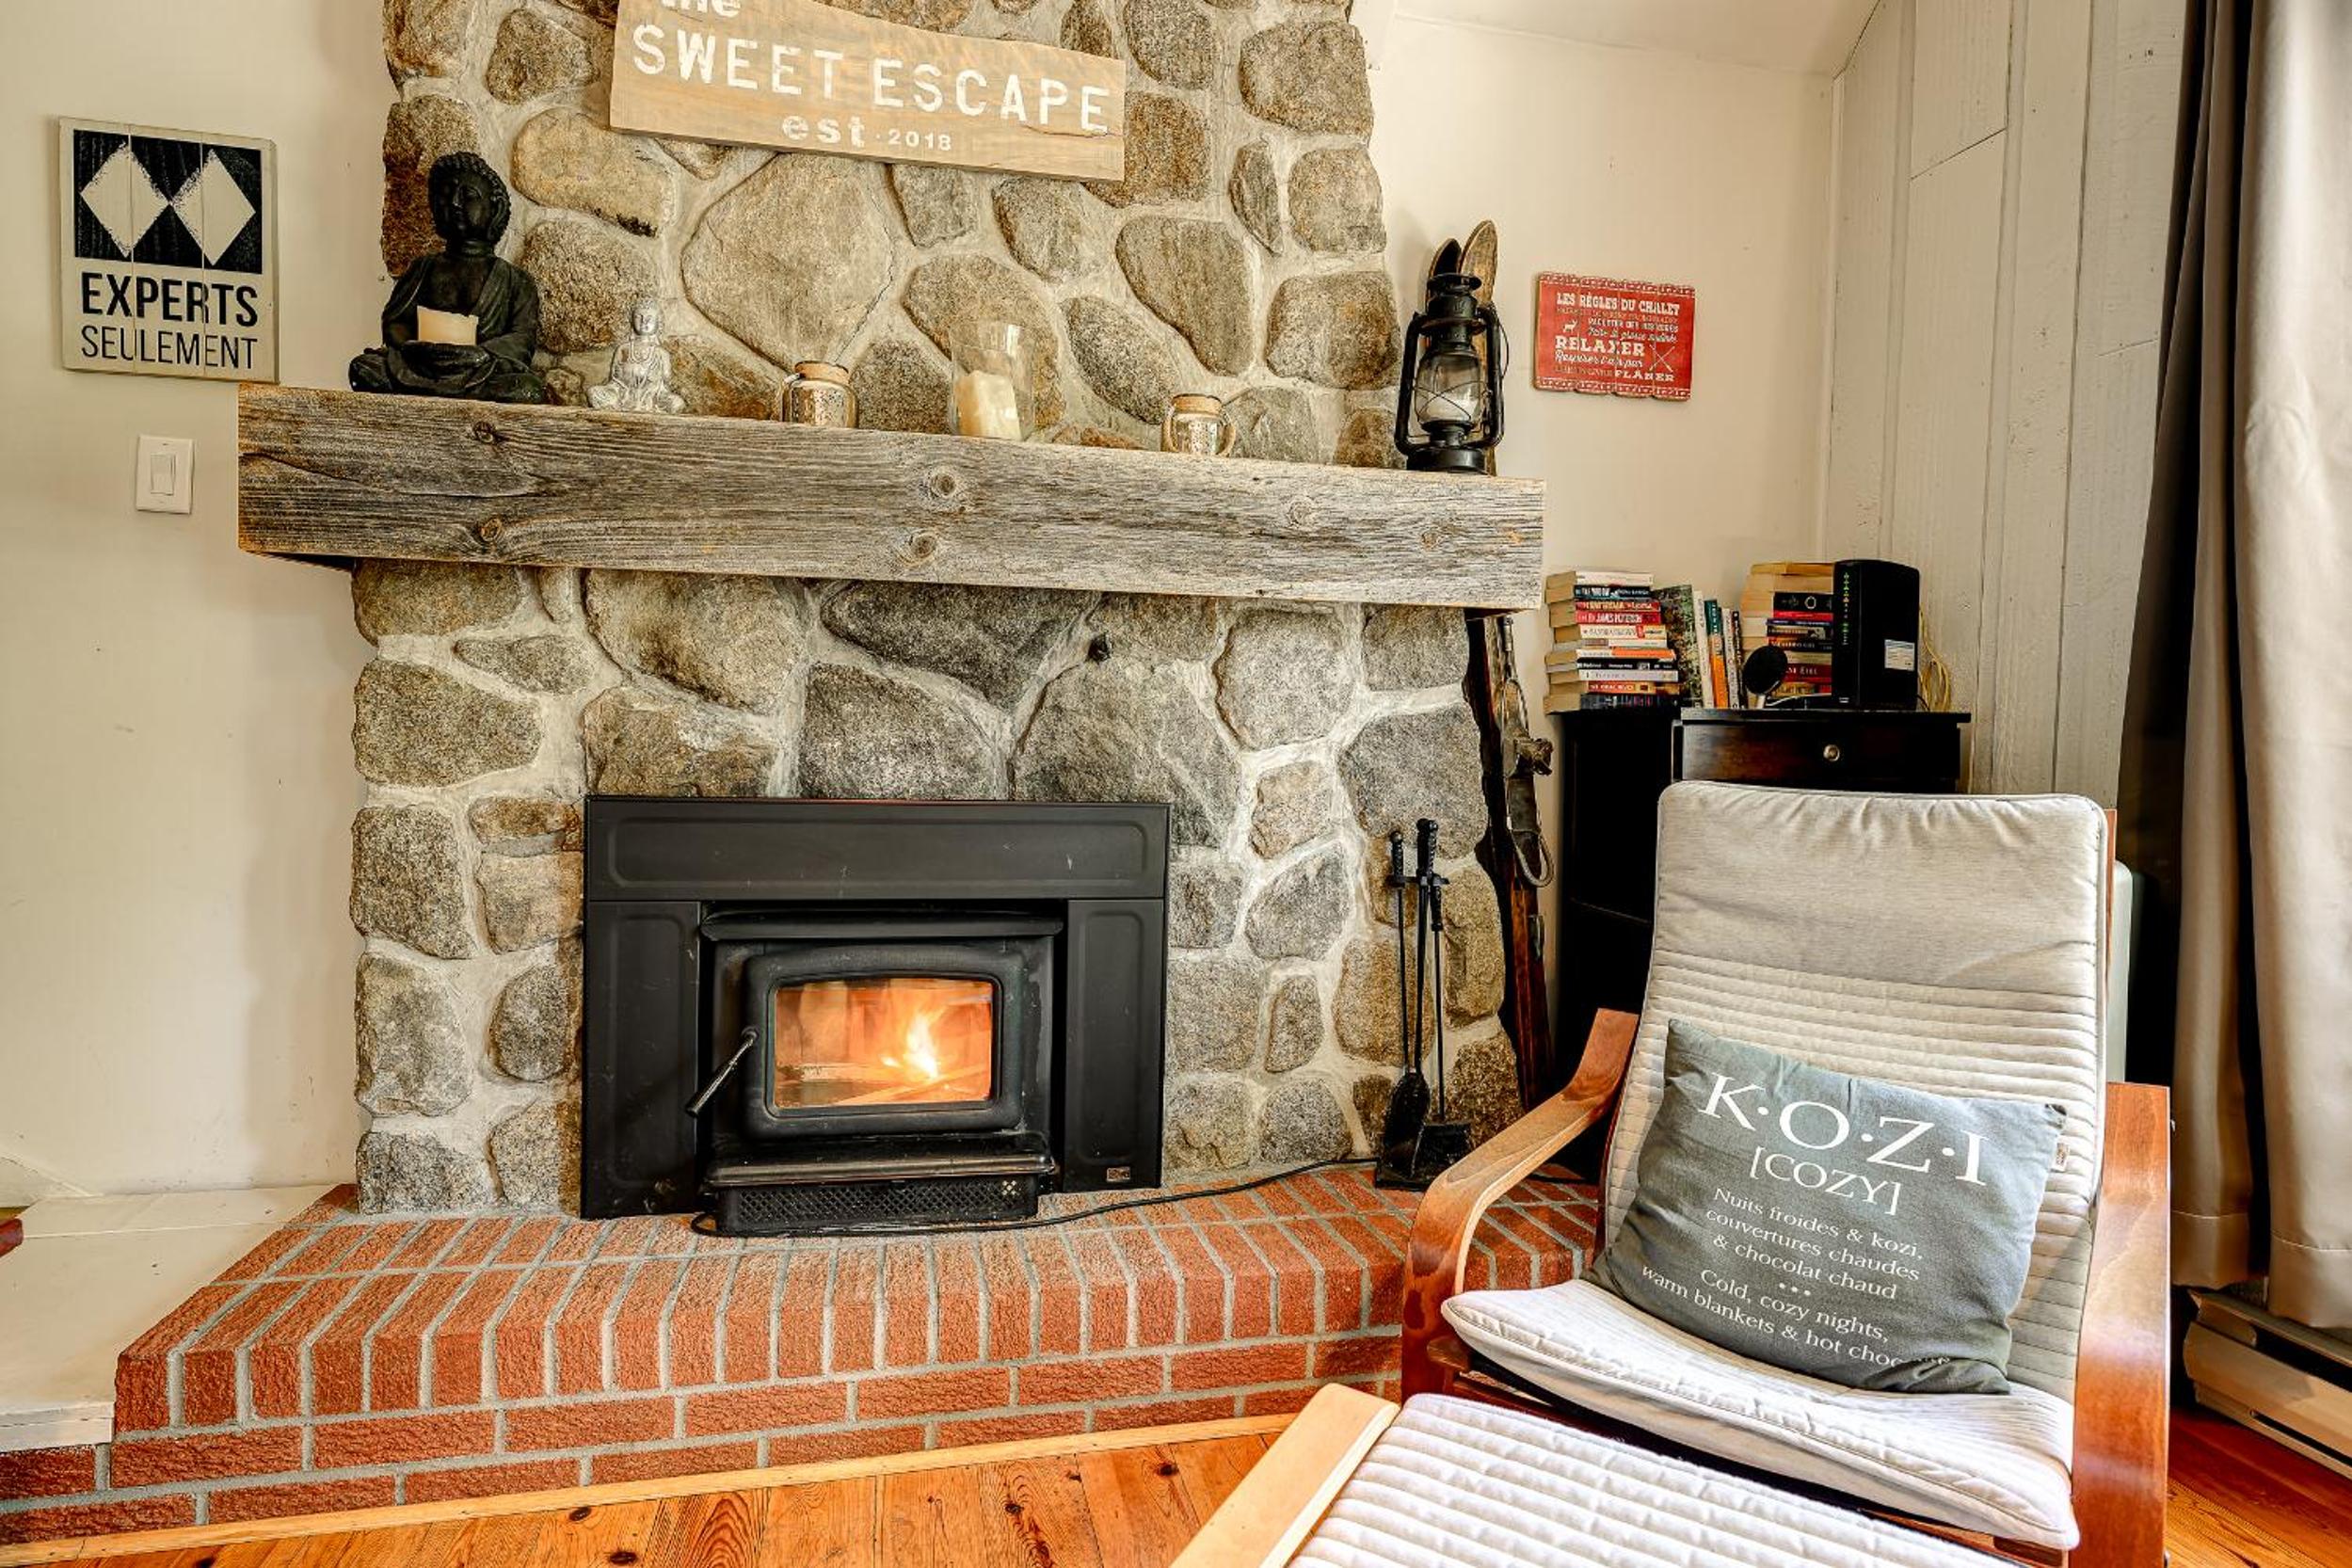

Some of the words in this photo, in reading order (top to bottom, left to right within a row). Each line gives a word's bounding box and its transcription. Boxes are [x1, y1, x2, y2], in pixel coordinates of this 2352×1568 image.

[632, 24, 844, 100] SWEET
[872, 57, 1111, 134] ESCAPE
[888, 128, 952, 152] 2018
[81, 271, 258, 328] EXPERTS
[1556, 292, 1576, 307] LES
[1621, 297, 1636, 312] DU
[1640, 300, 1680, 316] CHALET
[81, 325, 258, 369] SEULEMENT
[1555, 335, 1645, 357] RELAXER
[1714, 1188, 1763, 1215] Nuits
[1769, 1206, 1839, 1238] froides
[1847, 1228, 1864, 1244] &
[1706, 1209, 1822, 1256] couvertures
[1829, 1248, 1920, 1282] chaudes
[1713, 1234, 1729, 1250] &
[1735, 1243, 1822, 1280] chocolat
[1829, 1272, 1897, 1300] chaud
[1641, 1266, 1688, 1299] warm
[1694, 1288, 1776, 1335] blankets
[1782, 1324, 1799, 1341] &
[1805, 1329, 1843, 1353] hot
[1701, 1270, 1752, 1304] Cold,
[1760, 1295, 1810, 1321] cozy
[1816, 1311, 1889, 1344] nights,
